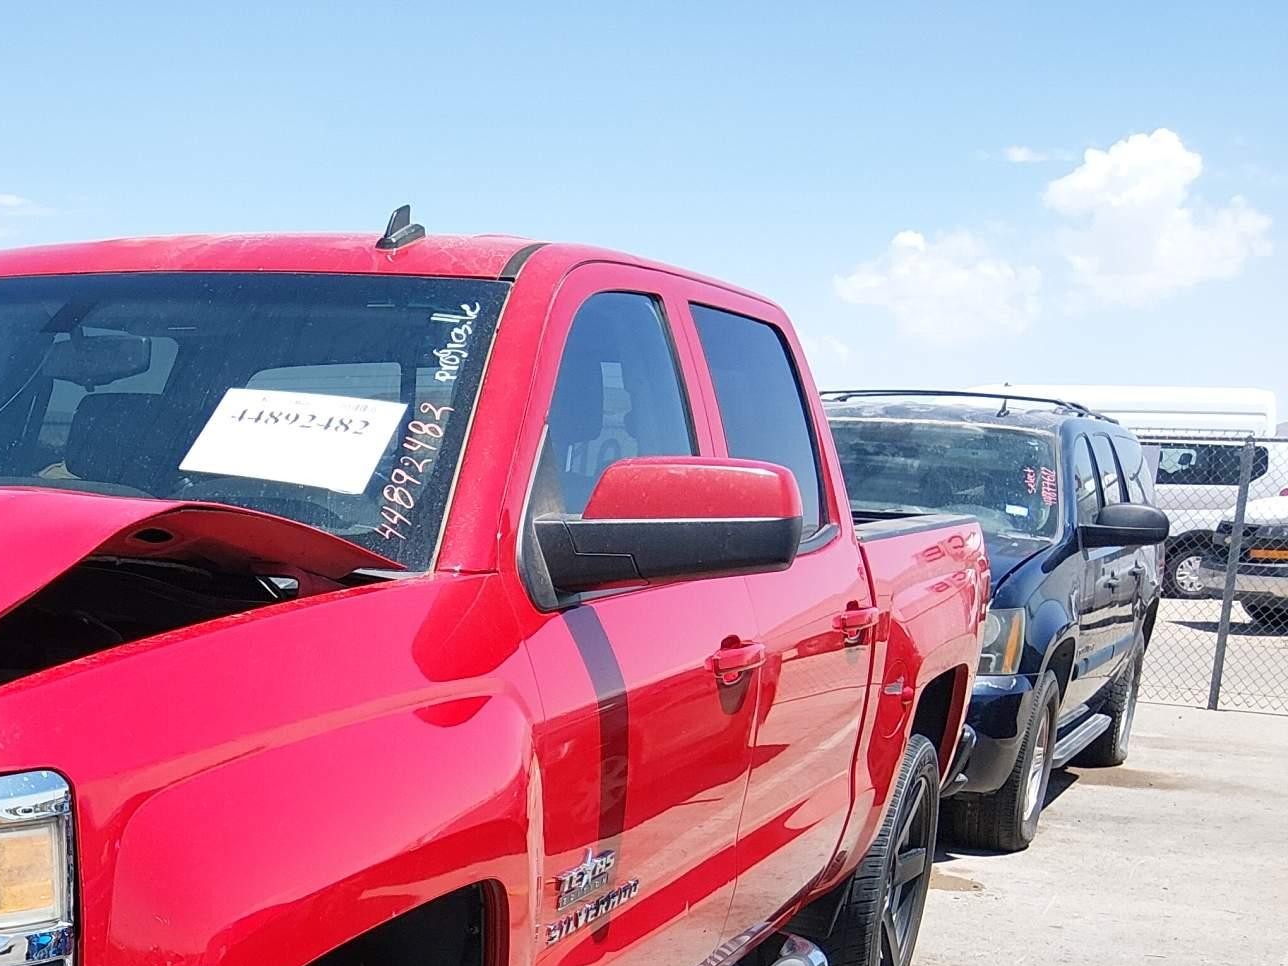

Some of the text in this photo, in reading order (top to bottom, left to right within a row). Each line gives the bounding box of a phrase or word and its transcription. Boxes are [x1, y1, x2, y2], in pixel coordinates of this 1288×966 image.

[231, 408, 370, 434] 44892482
[375, 402, 455, 540] 44892482
[546, 879, 640, 945] SILVERADO
